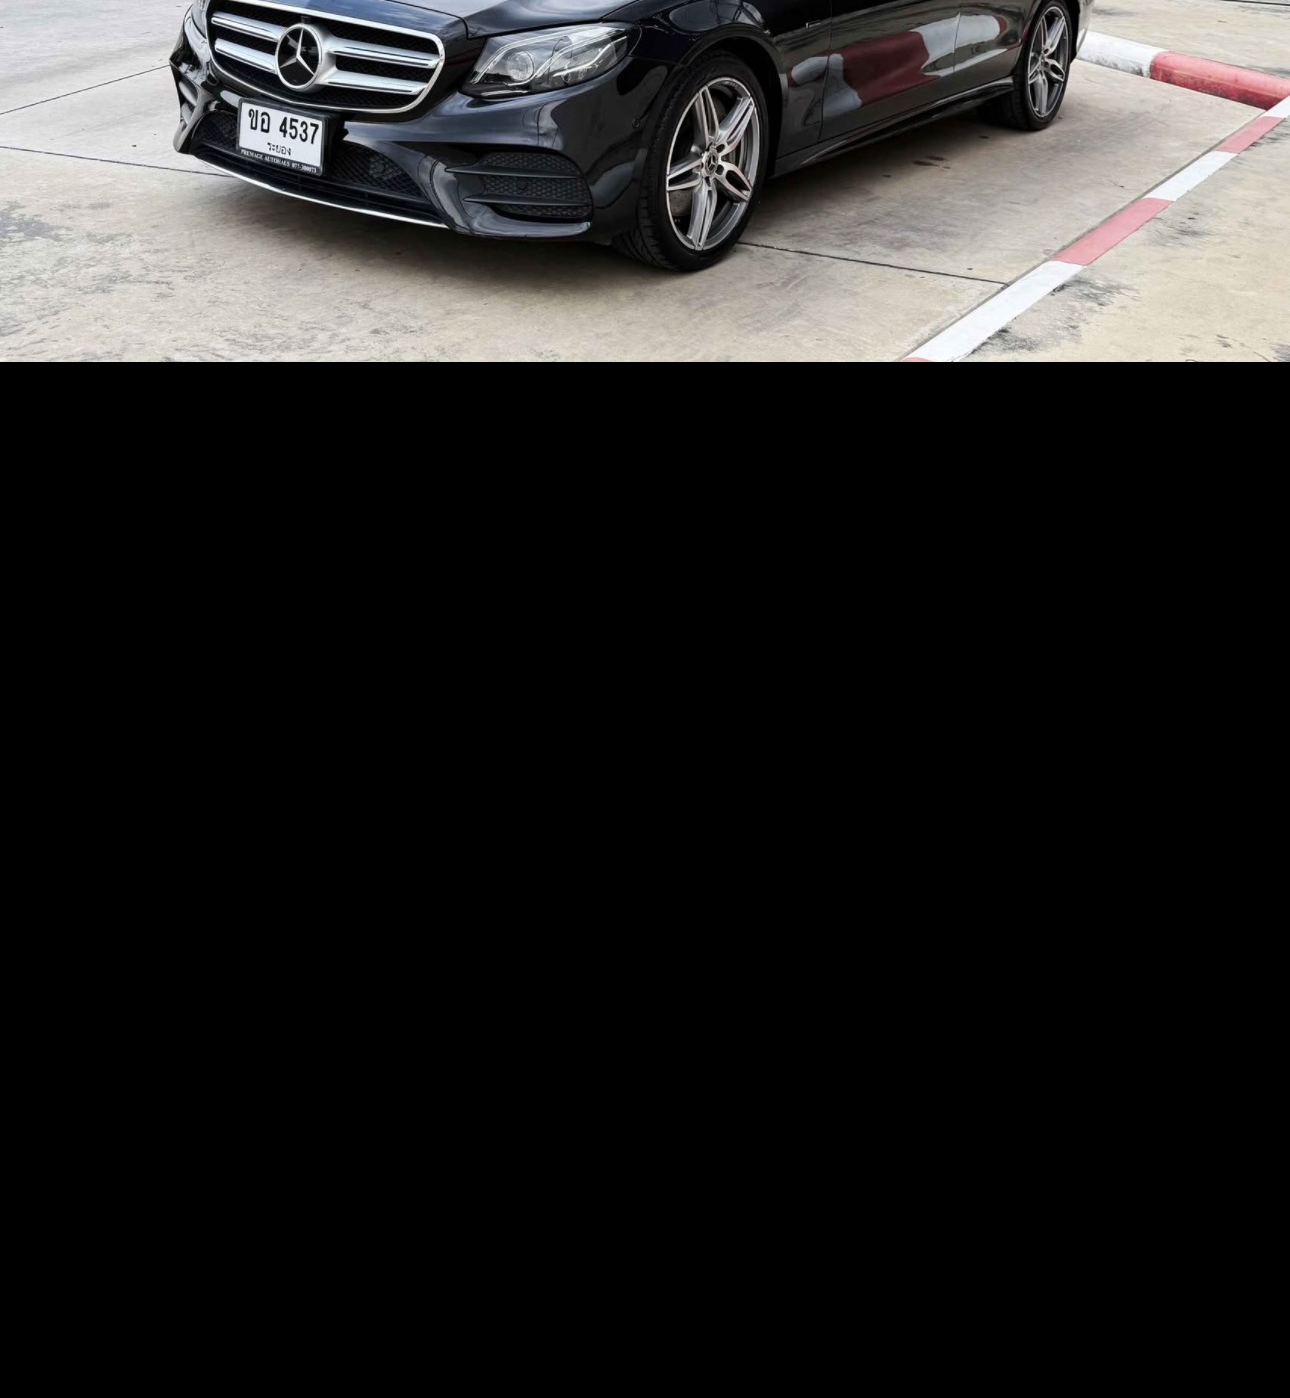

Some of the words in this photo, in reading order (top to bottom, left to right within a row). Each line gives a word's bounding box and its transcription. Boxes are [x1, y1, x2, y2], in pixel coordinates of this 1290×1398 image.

[248, 108, 271, 134] ขอ
[279, 116, 320, 145] 4537
[267, 142, 292, 156] ระยอง
